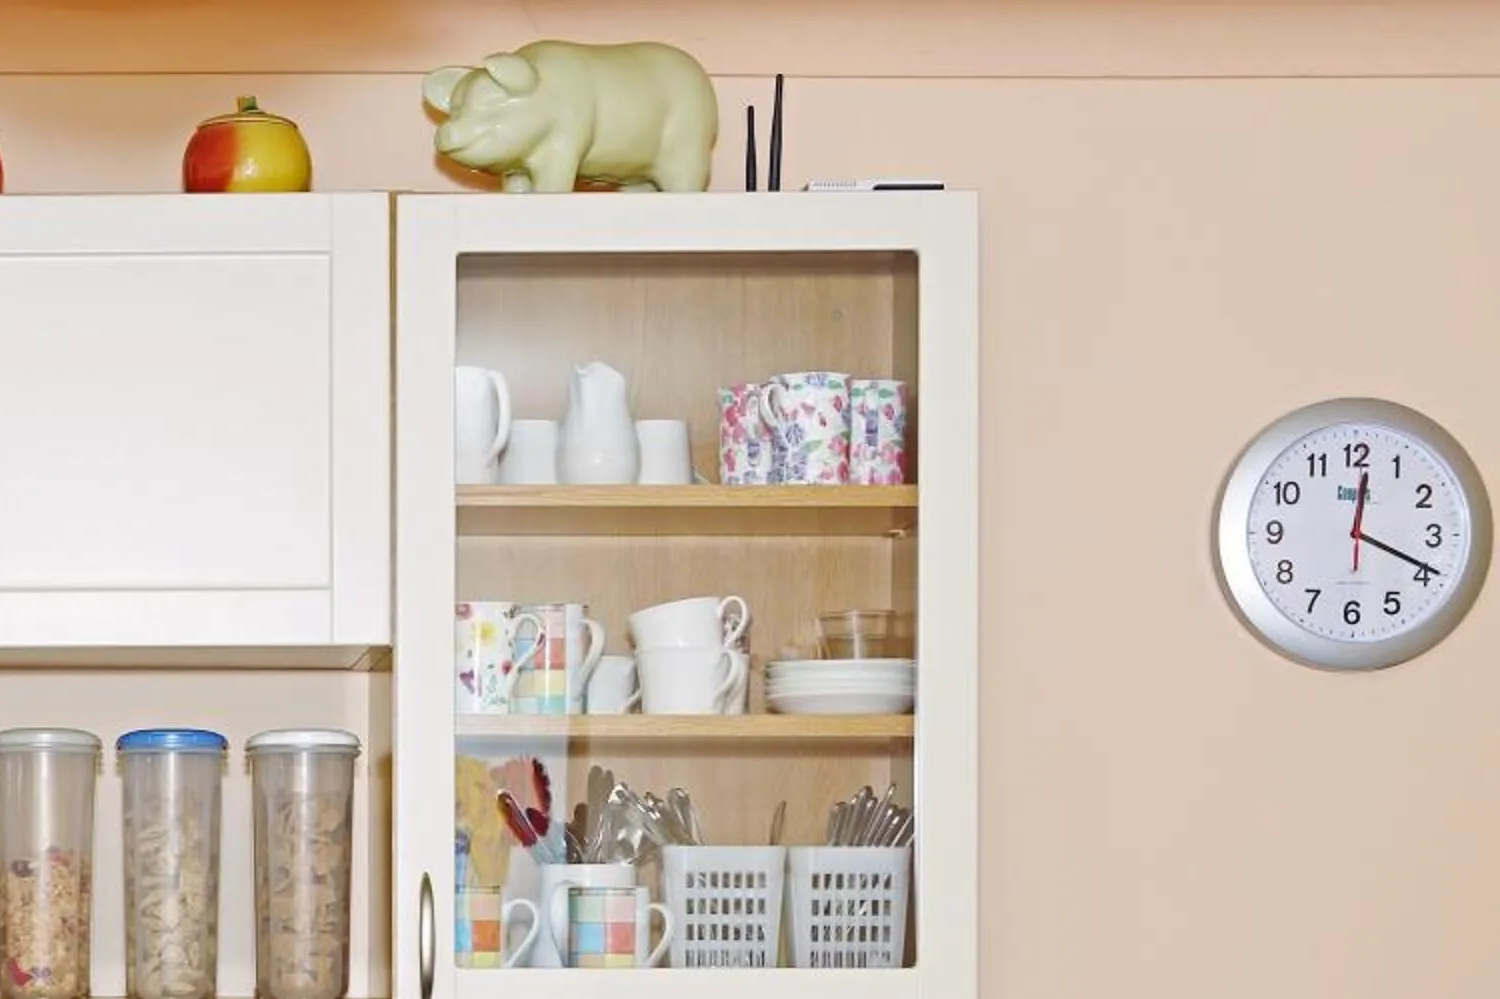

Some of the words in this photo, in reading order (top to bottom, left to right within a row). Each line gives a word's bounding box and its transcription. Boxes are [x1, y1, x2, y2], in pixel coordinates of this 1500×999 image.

[1306, 452, 1328, 478] 11
[1343, 442, 1371, 469] 12
[1392, 454, 1401, 479] 1
[1273, 481, 1301, 506] 10
[1415, 483, 1433, 509] 2
[1265, 519, 1284, 545] 9
[1425, 523, 1443, 548] 3
[1276, 559, 1294, 584] 8
[1412, 563, 1431, 587] 4
[1304, 588, 1322, 614] 7
[1343, 600, 1361, 625] 6
[1383, 591, 1401, 615] 5
